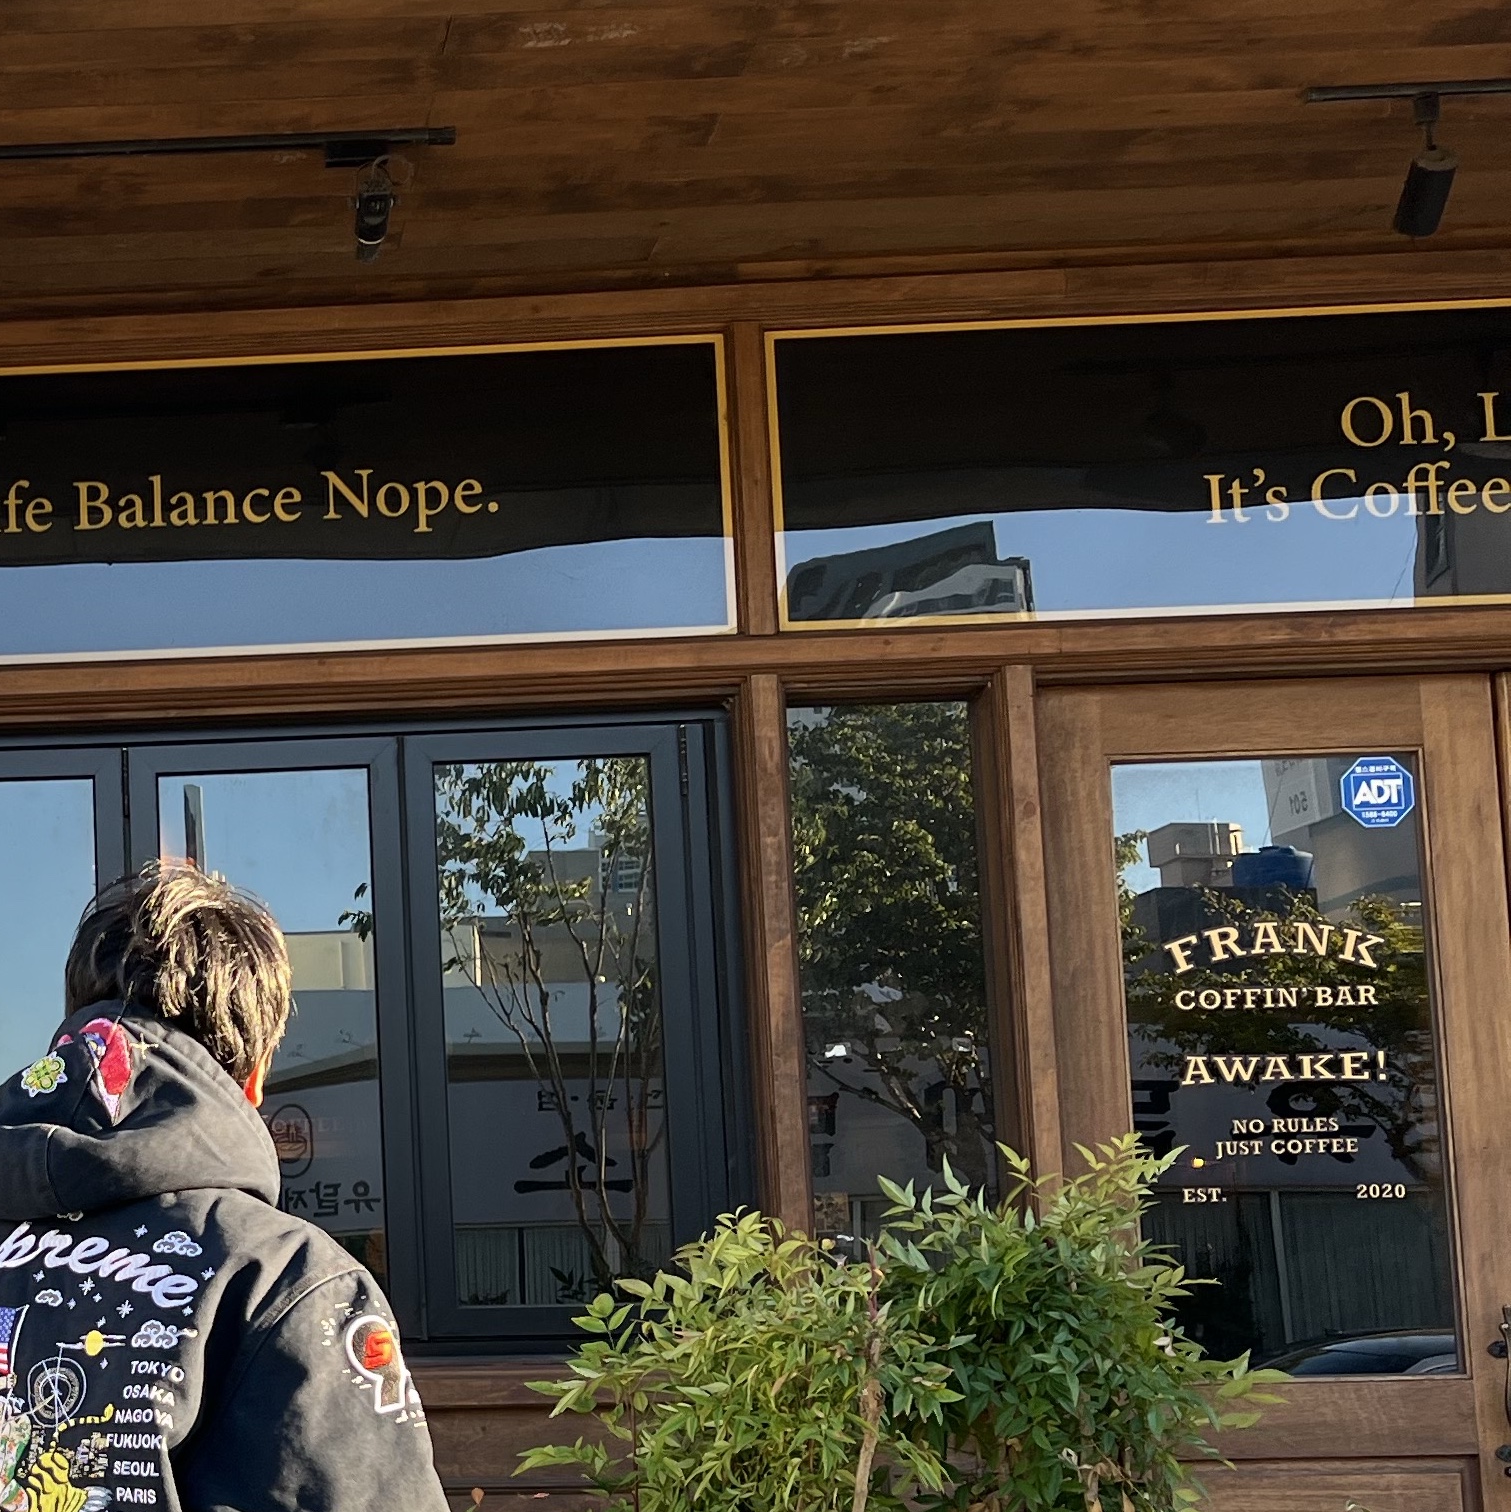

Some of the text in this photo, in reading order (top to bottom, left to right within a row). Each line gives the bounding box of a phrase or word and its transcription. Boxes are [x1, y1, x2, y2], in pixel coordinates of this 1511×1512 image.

[1341, 391, 1456, 451] Oh,
[73, 475, 303, 531] Balance
[320, 468, 500, 533] Nope.
[1203, 461, 1511, 524] It's Coffee
[1353, 779, 1403, 805] ADT
[1164, 921, 1386, 976] FRANK
[1316, 985, 1379, 1007] BAR
[1181, 1051, 1388, 1086] AWAKE!
[1232, 1117, 1340, 1135] NO RULES
[1215, 1137, 1359, 1159] JUST COFFEE
[1182, 1184, 1407, 1204] EST. 2020
[130, 1360, 185, 1383] TOKYO
[123, 1384, 175, 1407] OSAKA
[115, 1408, 174, 1429] NAGOYA
[113, 1461, 160, 1477] SEOUL
[116, 1487, 157, 1504] PARIS
